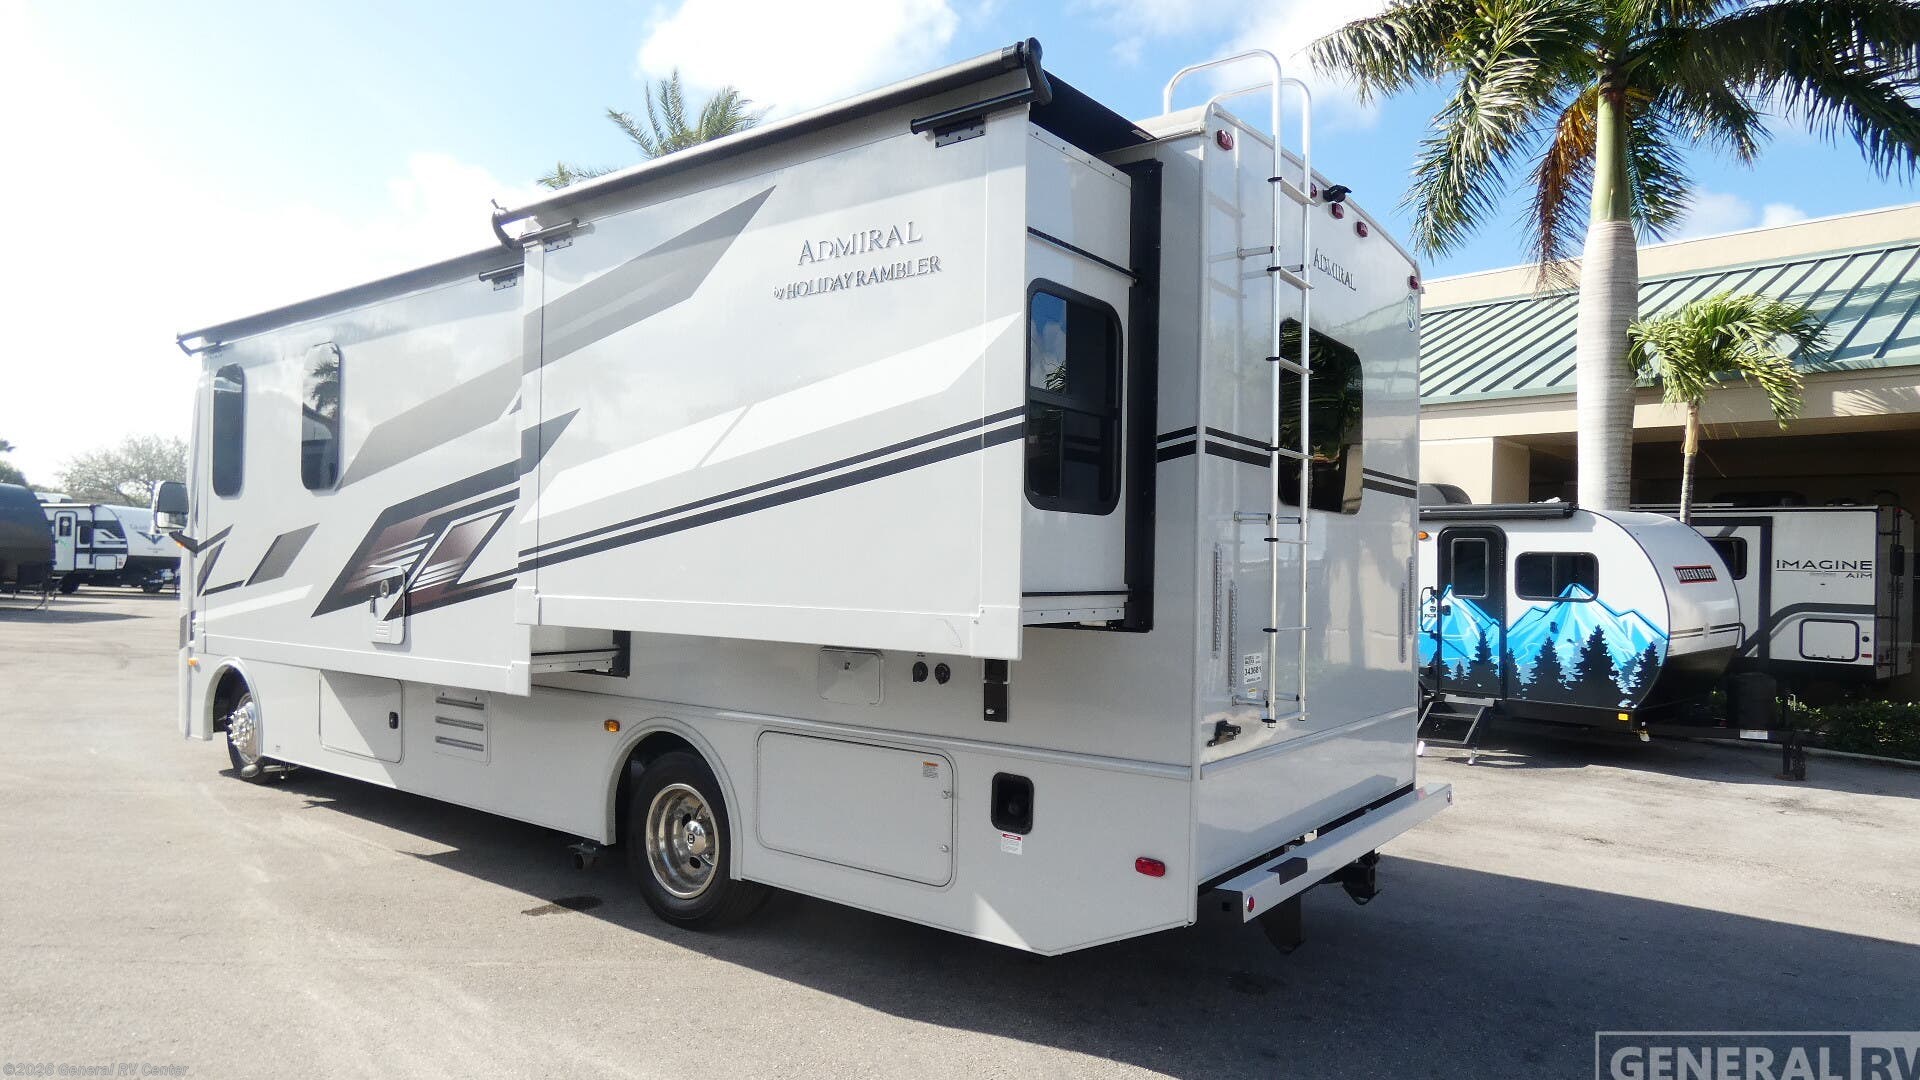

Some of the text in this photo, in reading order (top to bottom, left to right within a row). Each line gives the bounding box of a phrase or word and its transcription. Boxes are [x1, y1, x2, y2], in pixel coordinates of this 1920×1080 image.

[798, 221, 922, 265] ADMIRAL
[1313, 248, 1357, 292] ADMIRAL
[1776, 559, 1872, 570] IMAGINE
